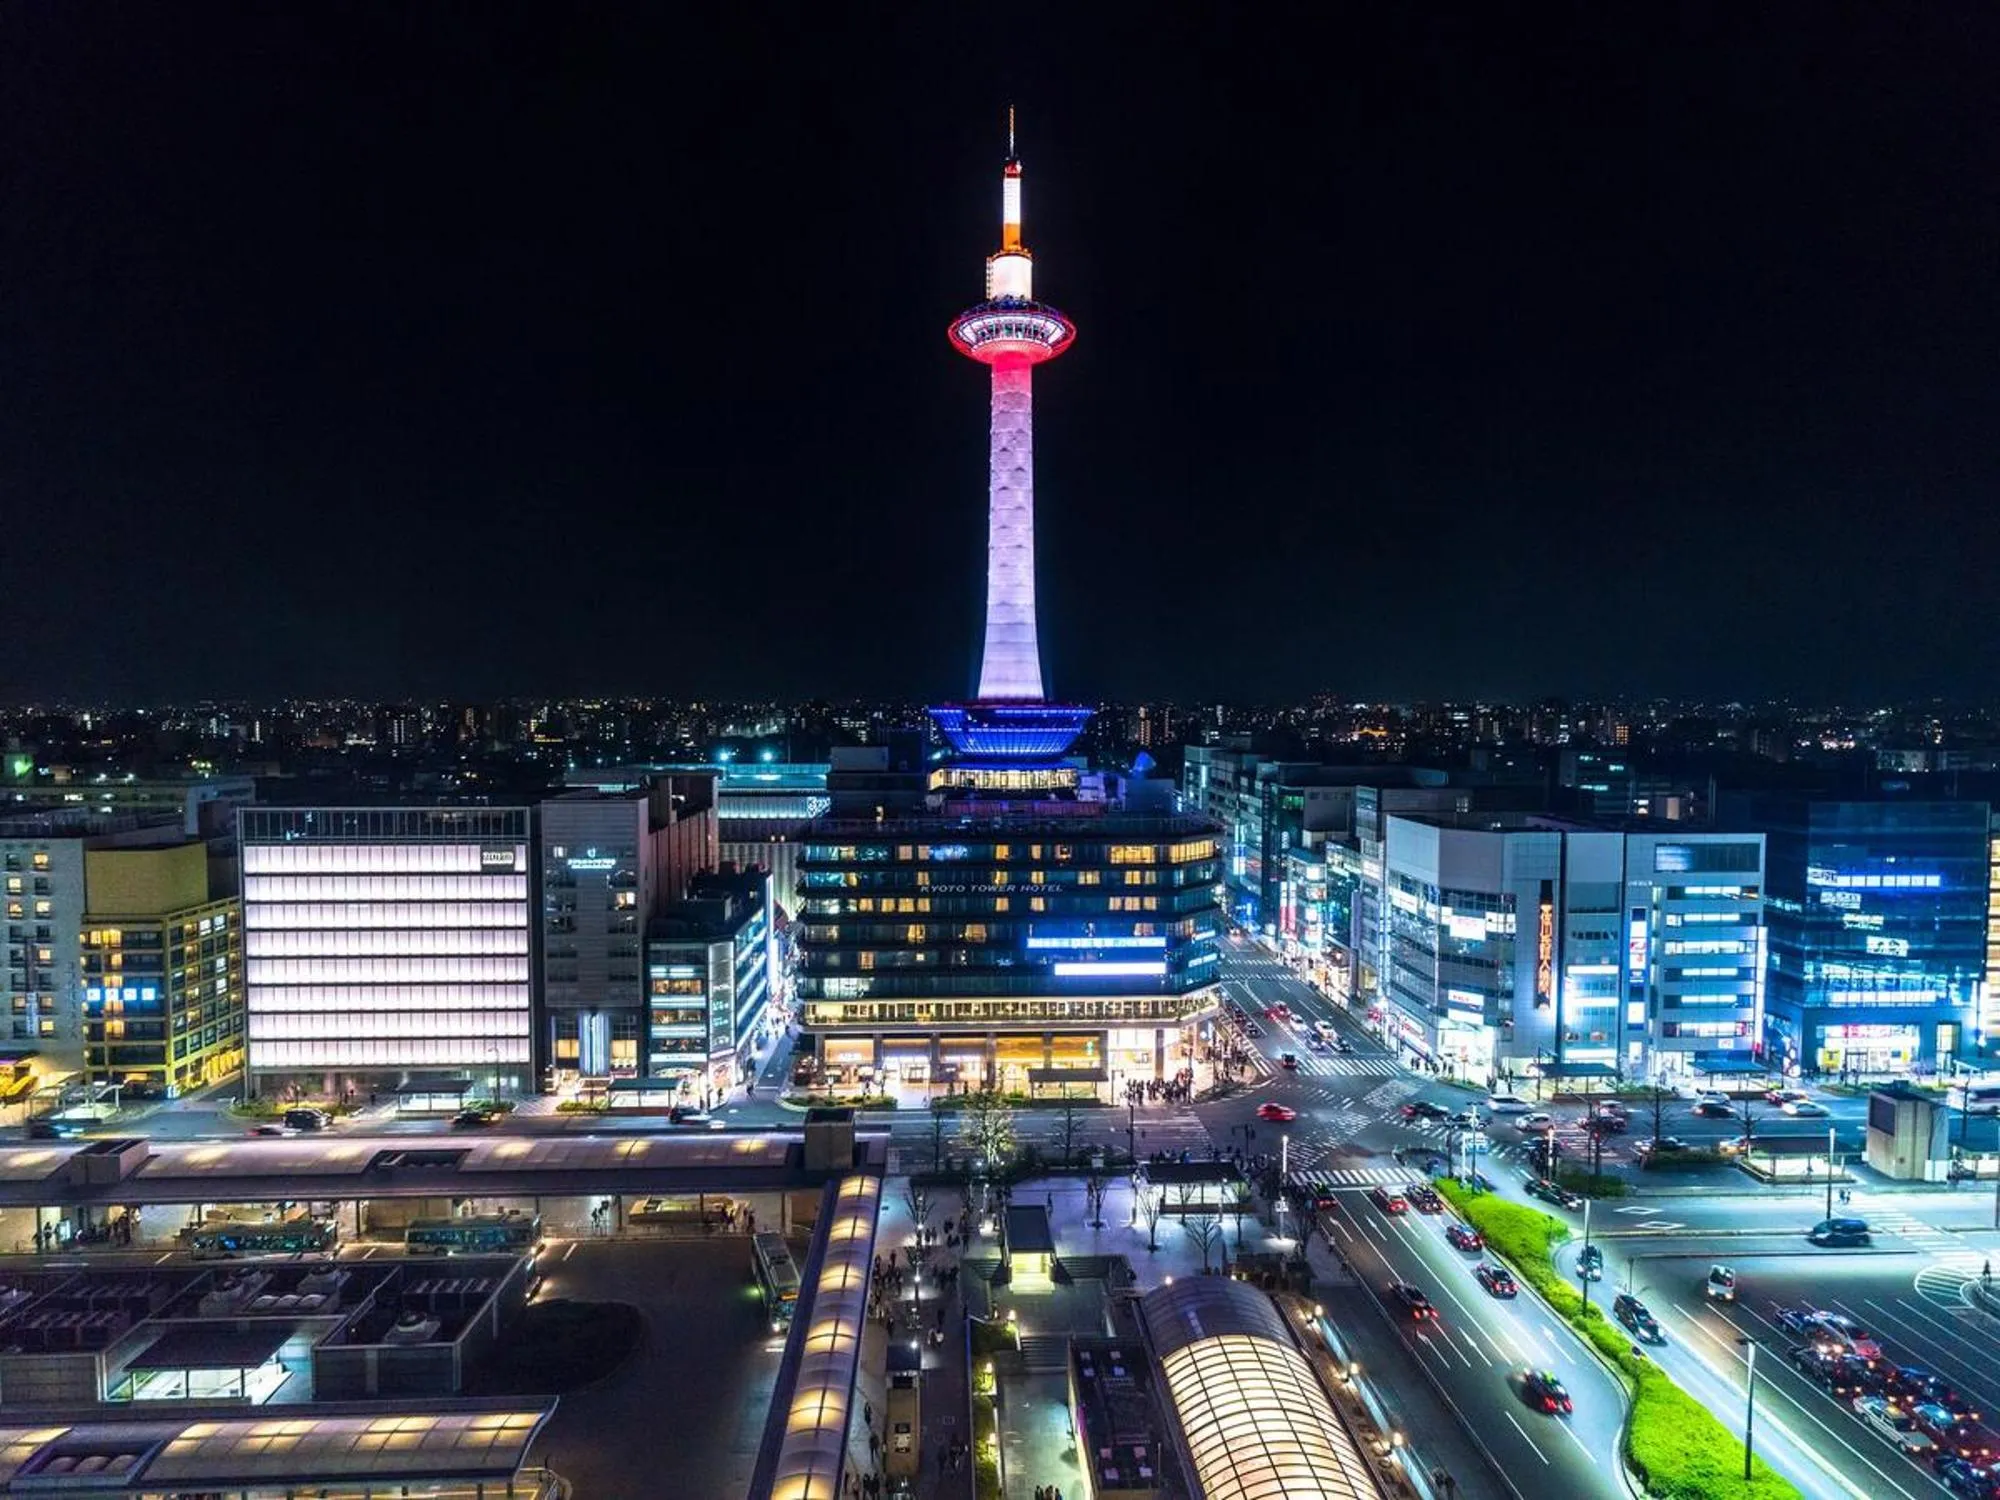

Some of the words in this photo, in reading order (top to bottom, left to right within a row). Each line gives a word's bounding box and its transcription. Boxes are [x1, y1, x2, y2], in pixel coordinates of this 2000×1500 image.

[920, 884, 966, 893] KYOTO
[970, 884, 1016, 893] TOWER
[1020, 884, 1063, 892] HOTEL
